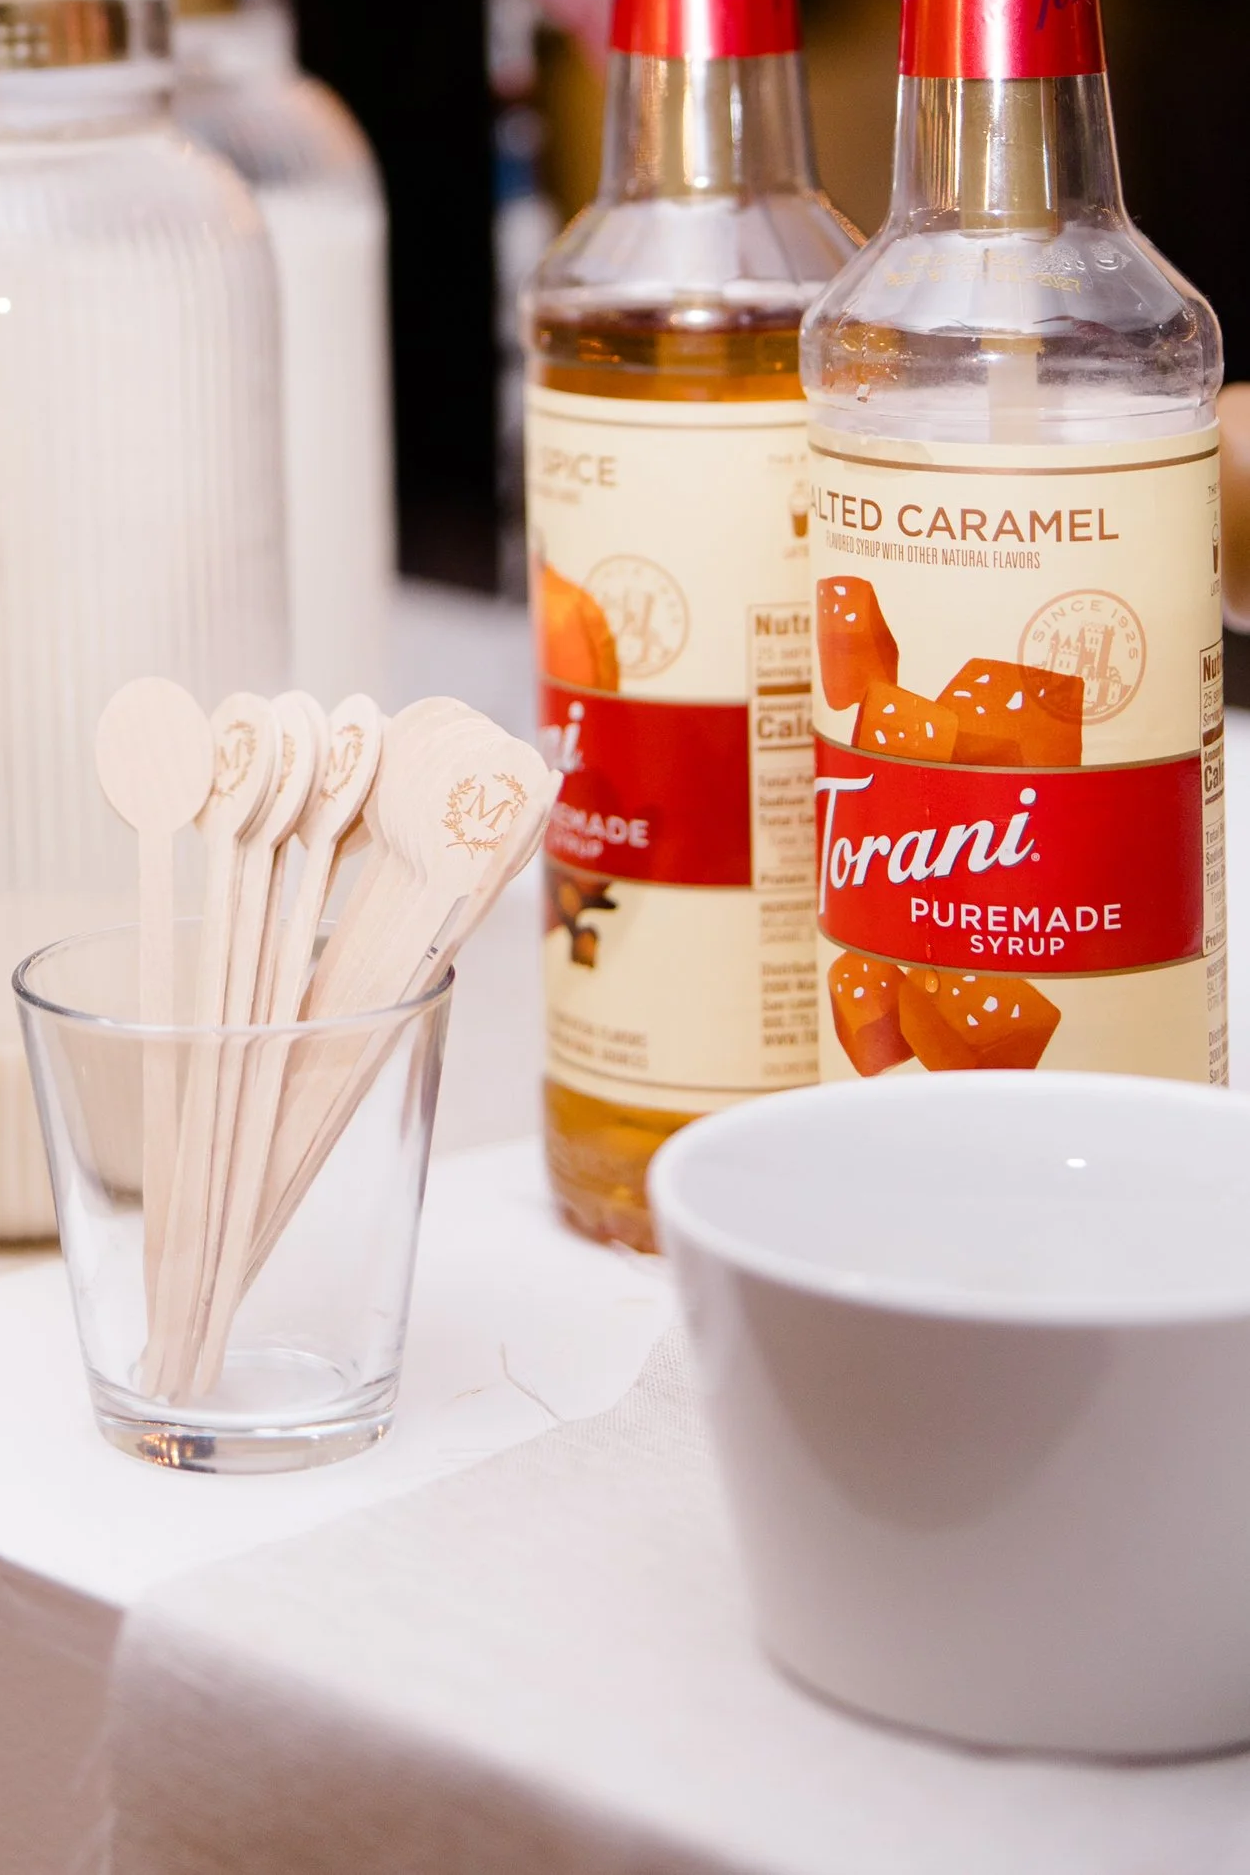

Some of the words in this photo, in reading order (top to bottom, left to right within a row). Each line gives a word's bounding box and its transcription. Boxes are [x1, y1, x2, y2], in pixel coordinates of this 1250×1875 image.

[897, 504, 1119, 543] CARAMEL
[856, 538, 881, 560] SYRUP
[882, 543, 904, 562] WITH
[907, 545, 938, 565] OTHER
[941, 548, 989, 568] NATURAL
[993, 550, 1040, 570] FLAVORS
[1032, 599, 1103, 643] SINCE
[1110, 607, 1139, 661] 1925
[463, 784, 513, 833] M
[911, 897, 1121, 933] PUREMADE
[970, 934, 1065, 956] SYRUP
